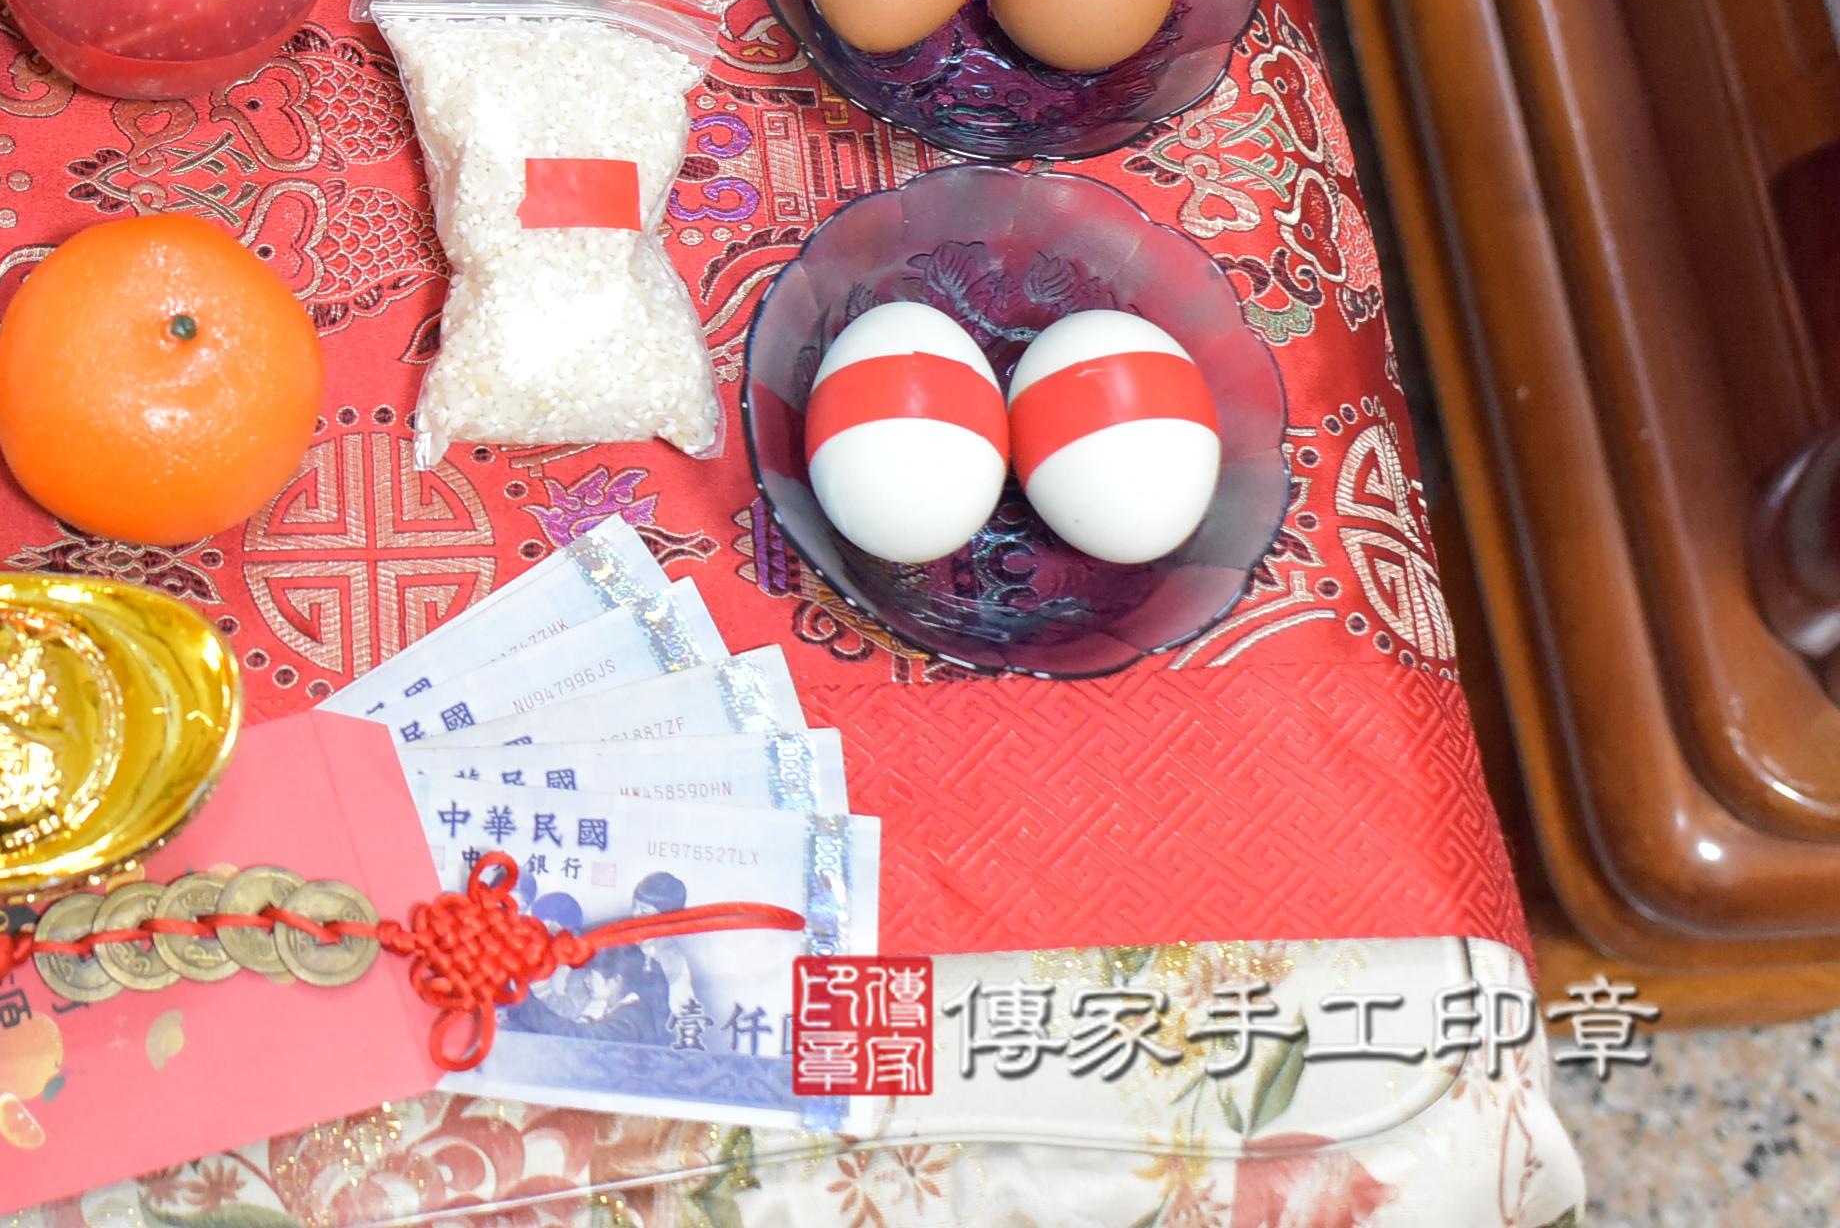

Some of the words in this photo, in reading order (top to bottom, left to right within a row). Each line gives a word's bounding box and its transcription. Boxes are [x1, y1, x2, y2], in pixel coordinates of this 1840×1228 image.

[437, 800, 609, 853] 中華民國
[461, 845, 583, 880] 中銀行
[665, 998, 793, 1056] 壹仟
